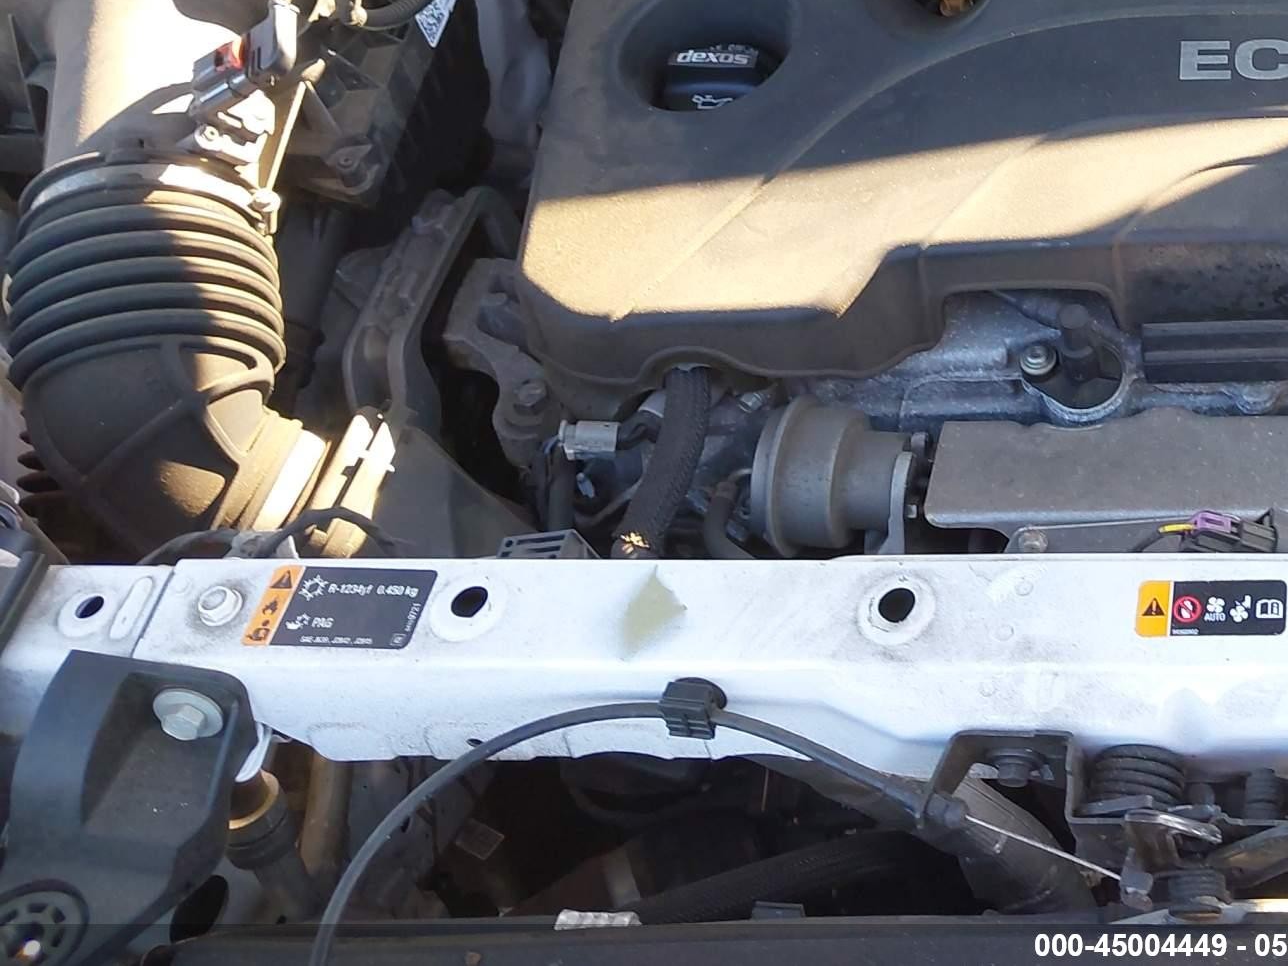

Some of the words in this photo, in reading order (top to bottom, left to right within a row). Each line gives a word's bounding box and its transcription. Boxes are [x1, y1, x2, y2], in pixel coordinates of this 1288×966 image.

[676, 50, 749, 65] dexos
[311, 617, 335, 629] PAG
[1203, 612, 1227, 622] AUTO
